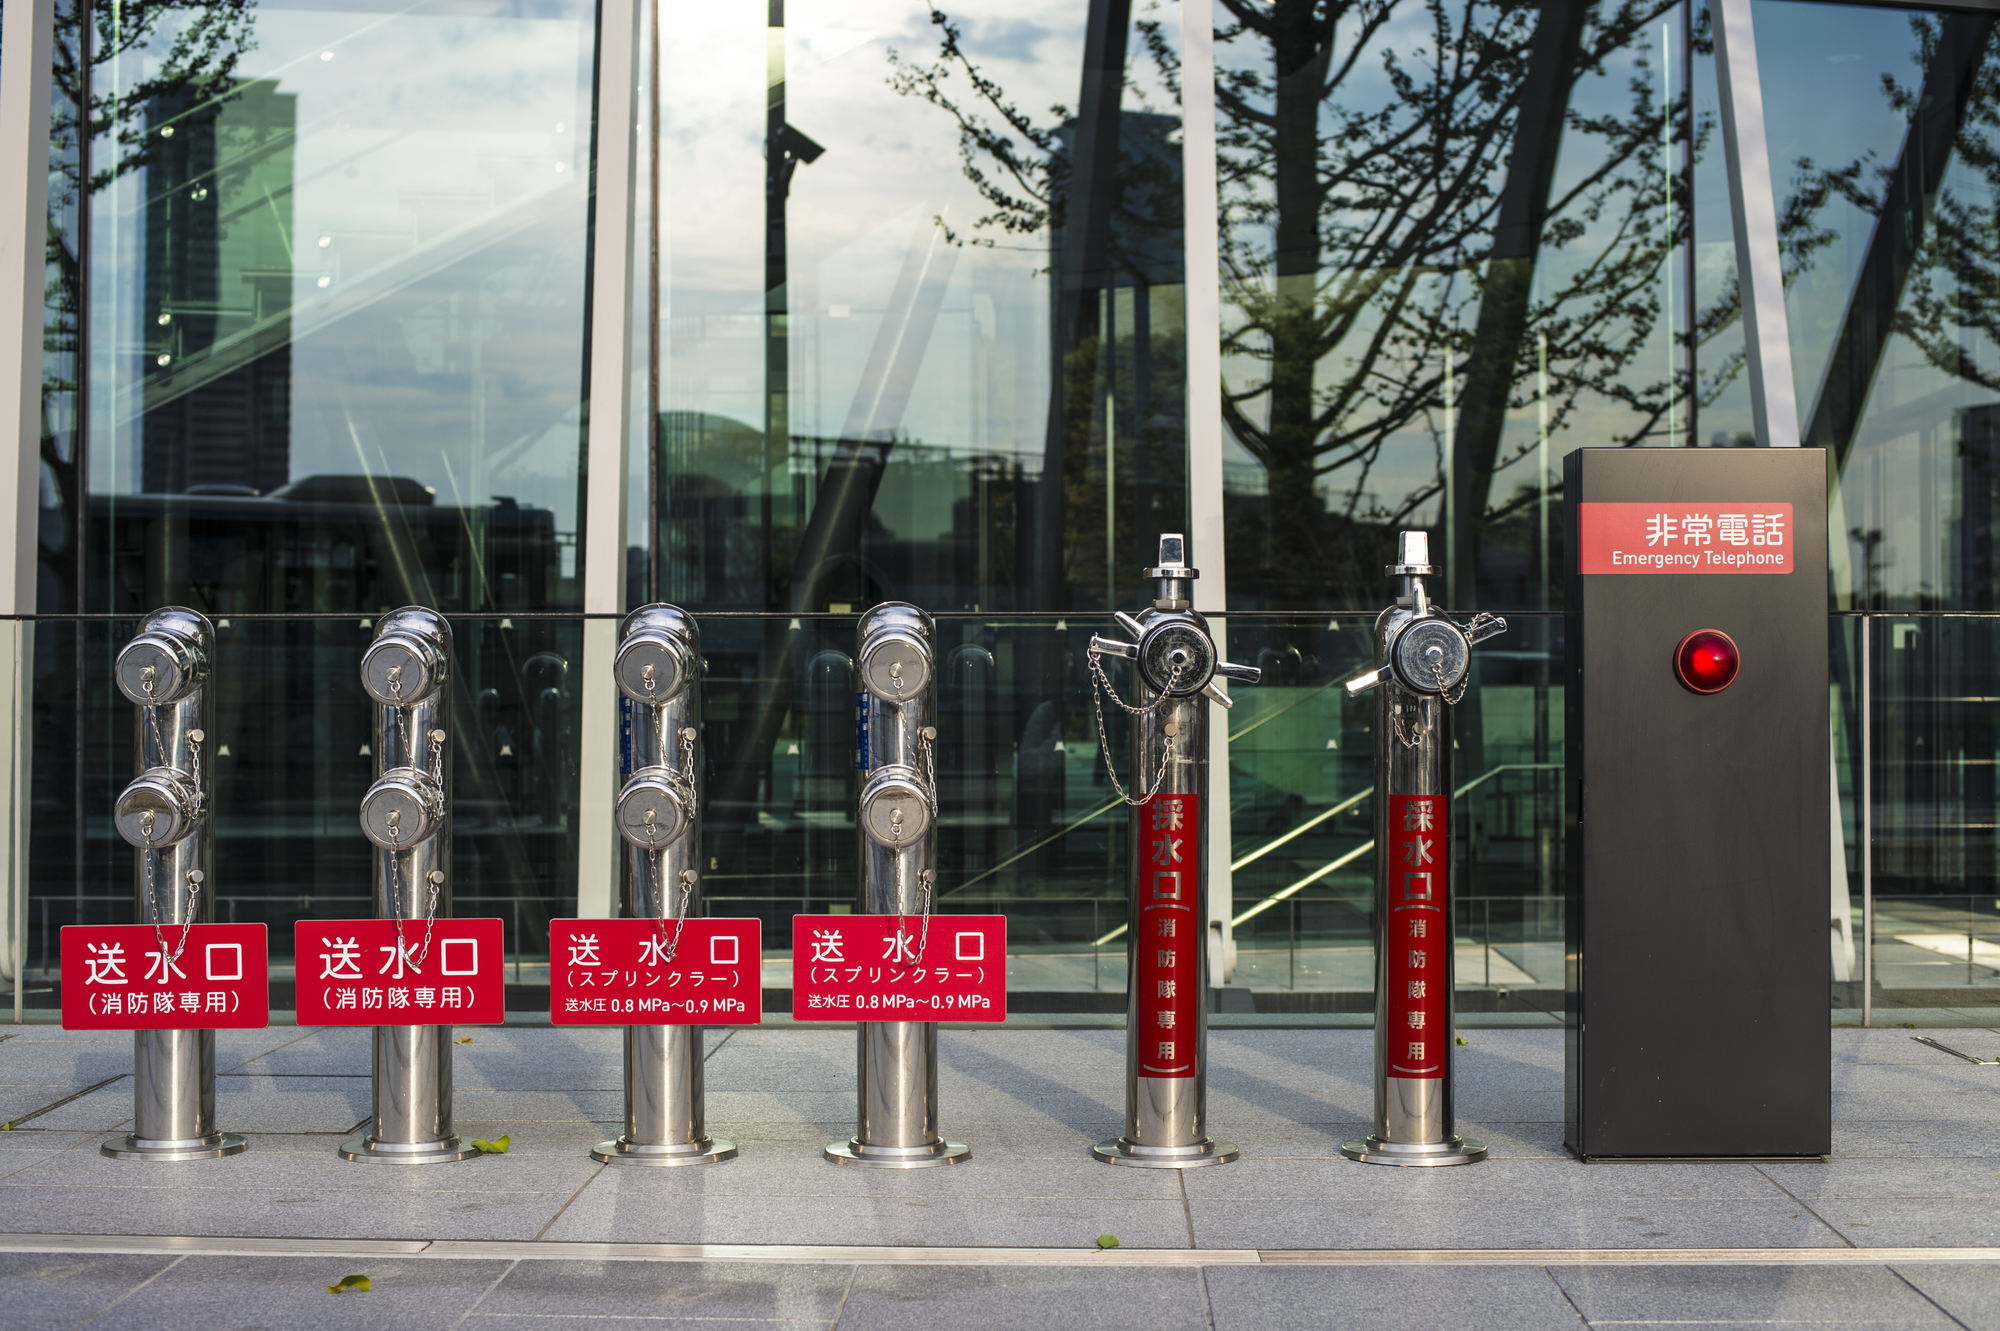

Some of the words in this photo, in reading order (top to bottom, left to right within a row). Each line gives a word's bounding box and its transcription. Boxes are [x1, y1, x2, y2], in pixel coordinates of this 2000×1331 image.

[1645, 512, 1785, 547] 非常電話
[1612, 550, 1700, 568] Emergency
[1703, 550, 1784, 568] Telephone
[1151, 799, 1184, 901] 採水口
[1402, 799, 1434, 901] 採水口
[319, 936, 479, 980] 送水口
[567, 933, 739, 967] 送水口
[810, 929, 985, 964] 送水口
[84, 941, 243, 985] 送水口
[811, 966, 985, 984] （スプリンクラー）
[567, 970, 739, 988] （スプリンクラー）
[89, 990, 239, 1015] （消防隊専用）
[323, 985, 475, 1010] （消防隊専用）
[564, 997, 607, 1012] 送水圧
[611, 998, 634, 1013] 0.8
[713, 998, 745, 1013] MPa
[808, 994, 850, 1009] 送水圧
[855, 994, 879, 1009] 0.8
[958, 994, 991, 1009] MPa
